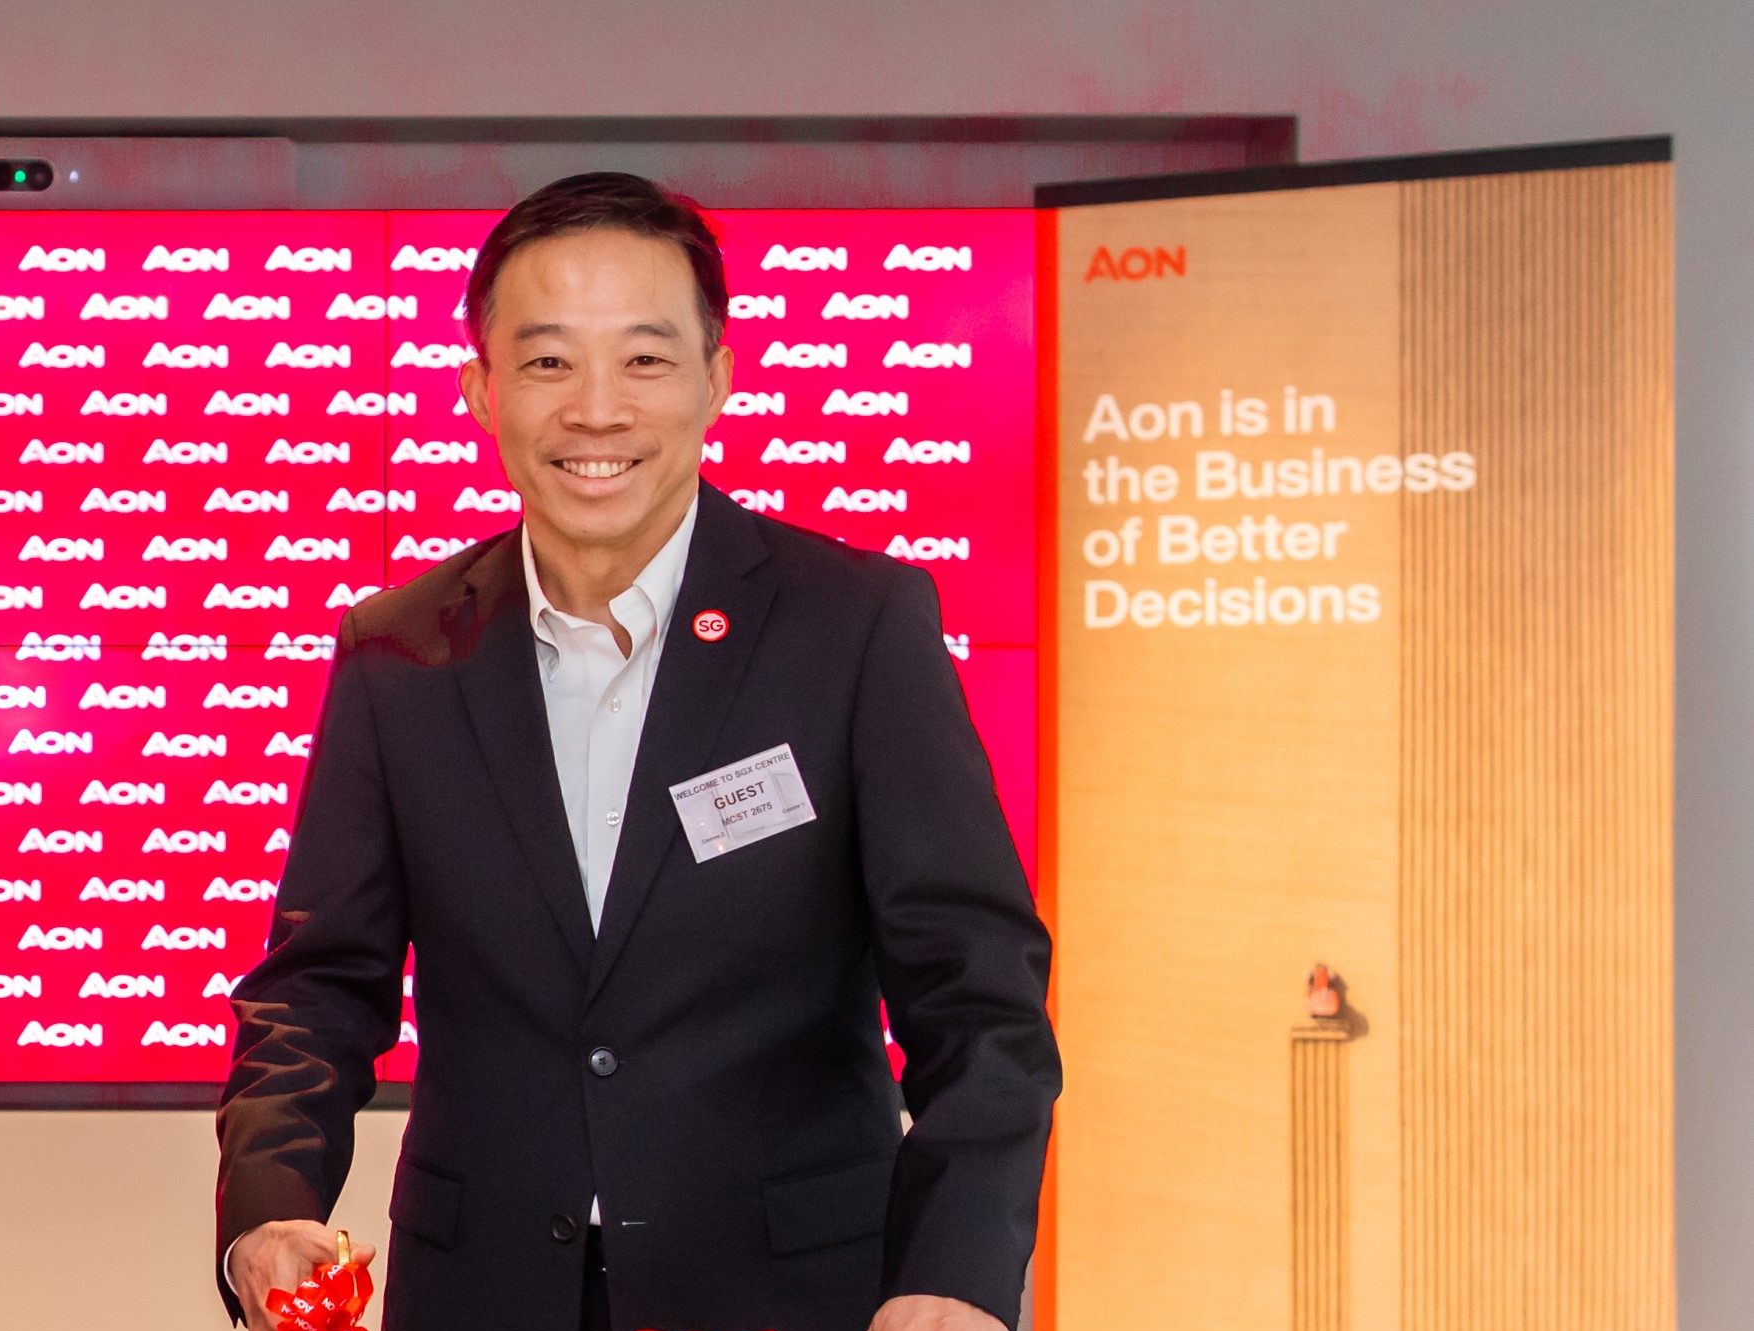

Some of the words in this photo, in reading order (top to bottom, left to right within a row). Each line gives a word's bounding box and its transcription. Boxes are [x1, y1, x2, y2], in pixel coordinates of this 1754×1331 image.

[19, 245, 105, 272] AON
[143, 245, 229, 272] AON
[265, 245, 351, 272] AON
[761, 245, 847, 272] AON
[883, 245, 971, 272] AON
[1084, 245, 1186, 284] AON
[80, 293, 168, 320] AON
[204, 293, 290, 320] AON
[326, 293, 417, 320] AON
[728, 293, 785, 320] ON
[822, 293, 908, 320] AON
[19, 342, 104, 368] AON
[143, 342, 228, 368] AON
[265, 342, 350, 368] AON
[760, 342, 847, 368] AON
[883, 342, 971, 368] AON
[81, 390, 166, 416] AON
[204, 390, 289, 416] AON
[327, 390, 416, 416] AON
[722, 390, 785, 416] ON
[822, 390, 908, 416] AON
[1084, 394, 1203, 443] Aon
[1220, 388, 1269, 437] is
[1283, 385, 1336, 434] in
[20, 438, 103, 464] AON
[143, 438, 227, 464] AON
[266, 438, 350, 464] AON
[391, 438, 477, 464] AON
[761, 438, 846, 464] AON
[884, 438, 970, 464] AON
[1084, 456, 1179, 504] the
[1195, 447, 1476, 501] Business
[80, 487, 166, 512] AON
[204, 487, 288, 512] AON
[326, 487, 415, 512] AON
[729, 487, 784, 512] ON
[822, 487, 906, 512] AON
[19, 535, 103, 561] AON
[142, 535, 227, 561] AON
[265, 535, 349, 561] AON
[885, 535, 969, 561] AON
[1083, 516, 1143, 567] of
[1157, 513, 1349, 565] Better
[80, 584, 166, 609] AON
[203, 584, 288, 609] AON
[1084, 575, 1383, 629] Decisions
[699, 620, 724, 632] SG
[15, 632, 101, 661] AON
[142, 632, 227, 661] AON
[79, 683, 166, 709] AON
[203, 683, 287, 709] AON
[8, 729, 92, 754] AON
[142, 732, 226, 757] AON
[674, 779, 720, 801] WELCOME
[721, 773, 734, 783] TO
[736, 767, 753, 779] SGX
[755, 751, 791, 770] CENTRE
[80, 780, 165, 805] AON
[204, 780, 287, 805] AON
[714, 781, 765, 810] GUEST
[722, 810, 748, 826] MCST
[751, 802, 773, 815] 2675
[19, 828, 102, 853] AON
[142, 828, 225, 853] AON
[79, 877, 164, 901] AON
[18, 925, 102, 950] AON
[142, 925, 225, 950] AON
[79, 973, 164, 998] AON
[18, 1021, 102, 1046] AON
[141, 1021, 225, 1046] AON
[292, 1296, 314, 1313] AON
